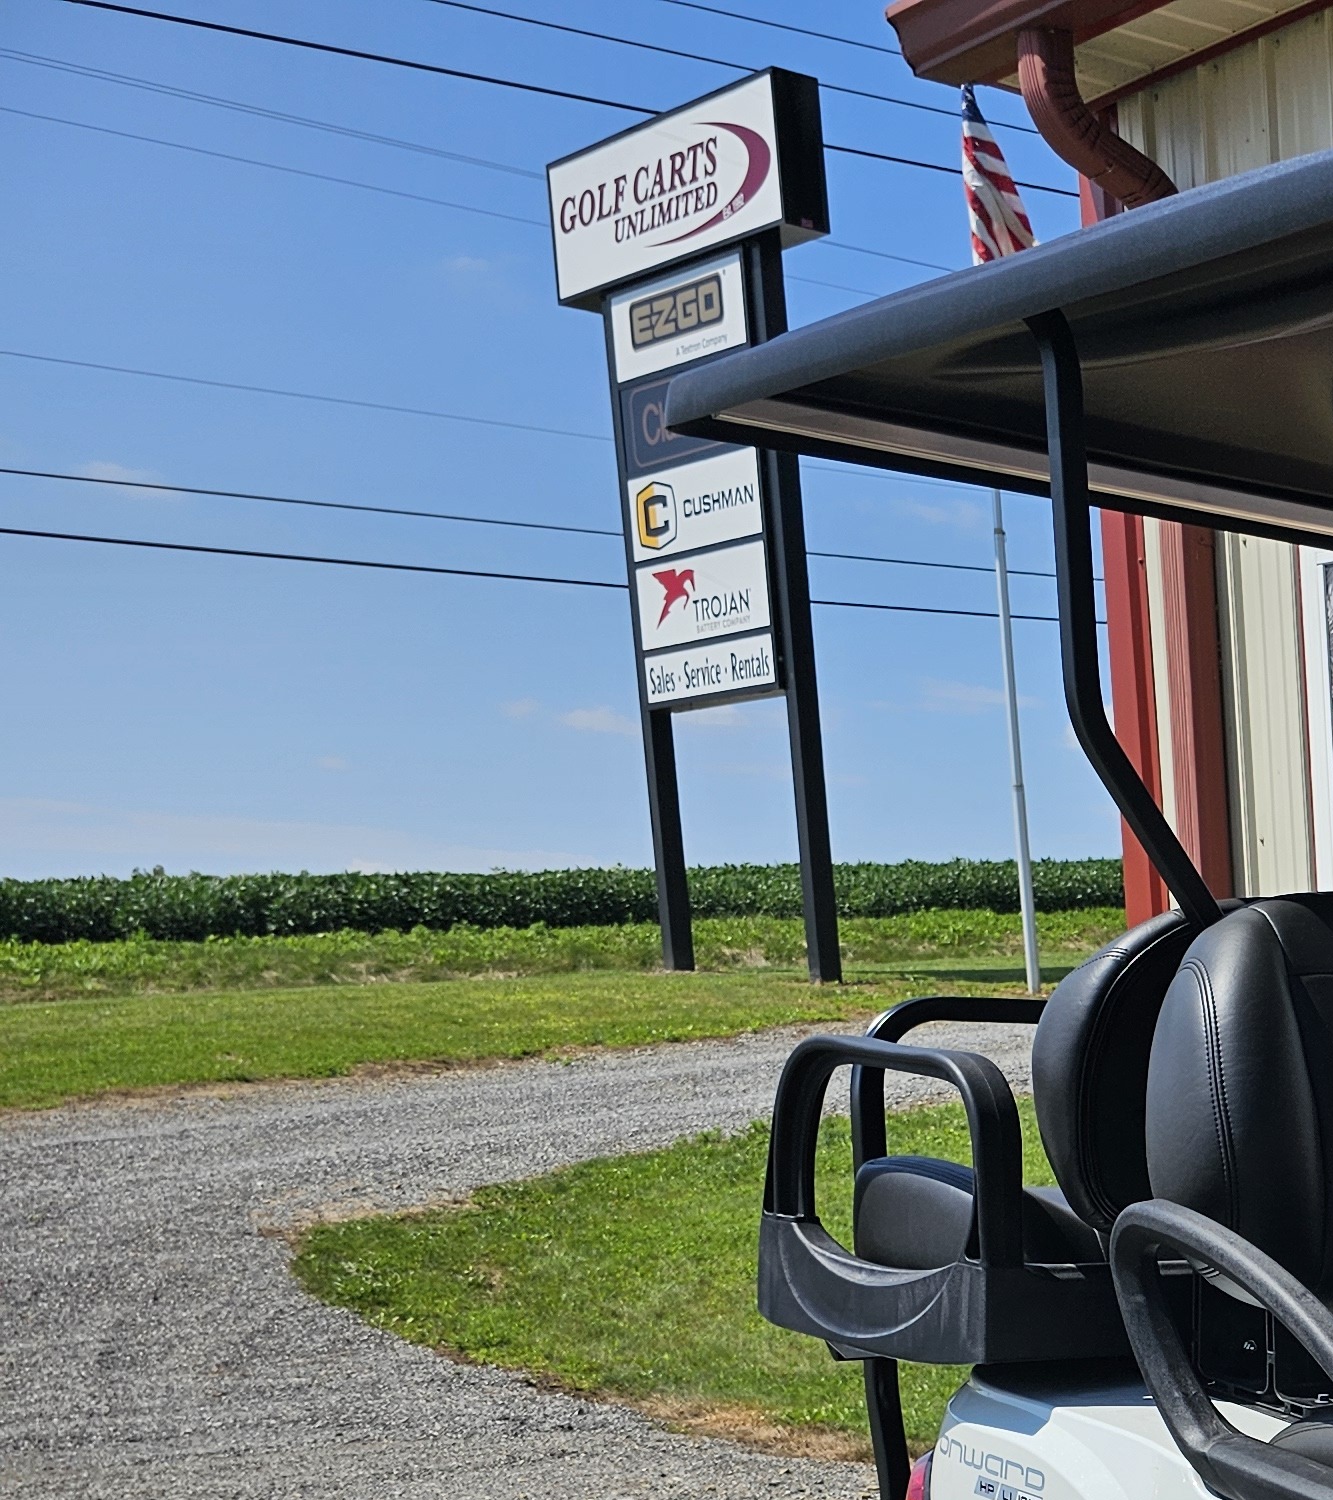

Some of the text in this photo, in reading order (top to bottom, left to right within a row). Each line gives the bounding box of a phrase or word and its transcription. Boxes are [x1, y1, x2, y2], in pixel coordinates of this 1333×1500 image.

[559, 136, 718, 234] GOLF CARTS
[614, 181, 718, 244] UNLIMITED
[683, 484, 754, 518] CUSHMAN
[692, 588, 750, 622] TROJAN
[649, 647, 770, 695] Sales Service Rentals
[979, 1480, 995, 1494] HP
